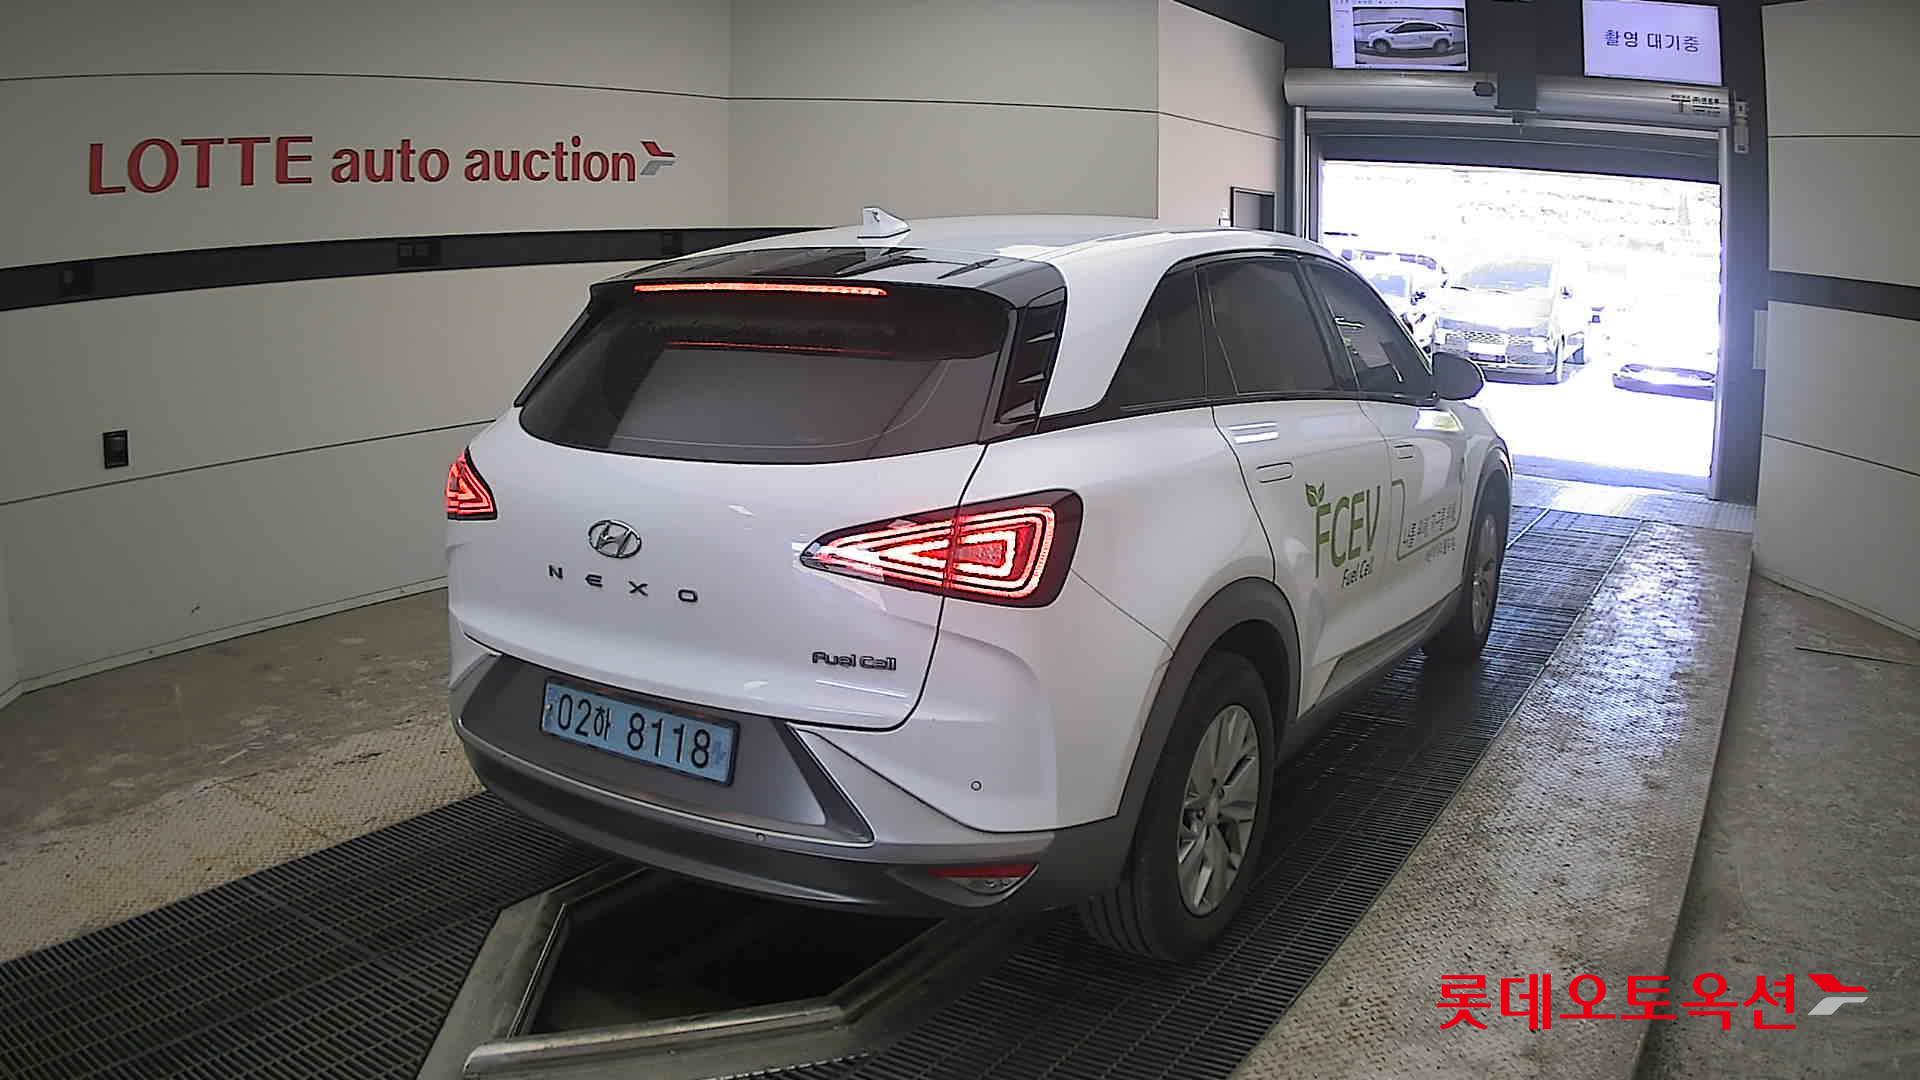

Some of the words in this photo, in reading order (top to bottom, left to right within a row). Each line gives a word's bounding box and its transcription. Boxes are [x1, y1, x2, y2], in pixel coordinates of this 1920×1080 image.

[1605, 30, 1638, 48] 촬영
[1647, 33, 1701, 52] 대기중
[89, 136, 313, 195] LOTTE
[331, 138, 450, 183] auto
[464, 135, 637, 183] auction
[1314, 485, 1381, 579] FCEV
[548, 564, 699, 603] NEXO
[812, 651, 856, 668] Fuel
[860, 656, 897, 671] Cell
[557, 694, 613, 741] 02하
[626, 712, 711, 768] 8118
